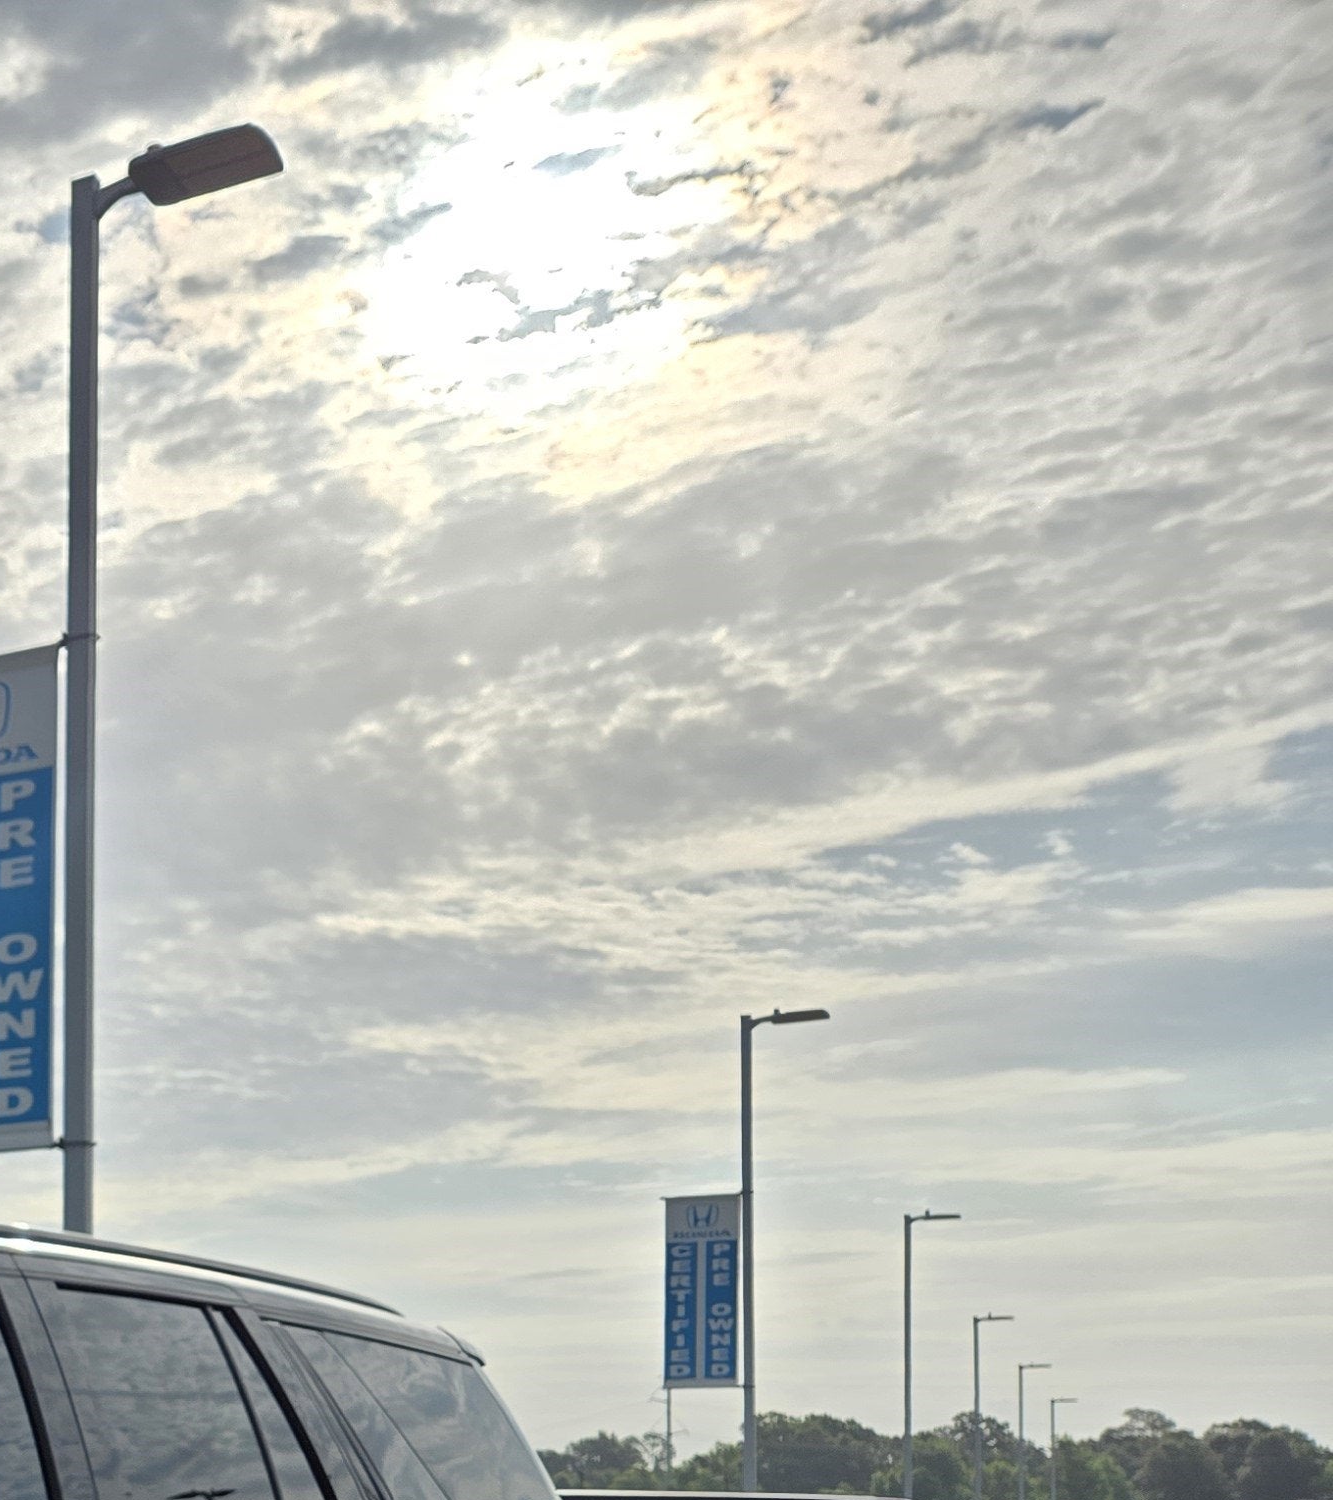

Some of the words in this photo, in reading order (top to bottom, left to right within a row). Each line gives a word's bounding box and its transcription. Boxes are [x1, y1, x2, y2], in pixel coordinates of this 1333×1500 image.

[711, 1243, 732, 1287] PRE
[669, 1245, 693, 1377] CERTIFIED
[708, 1302, 734, 1376] OWNED
